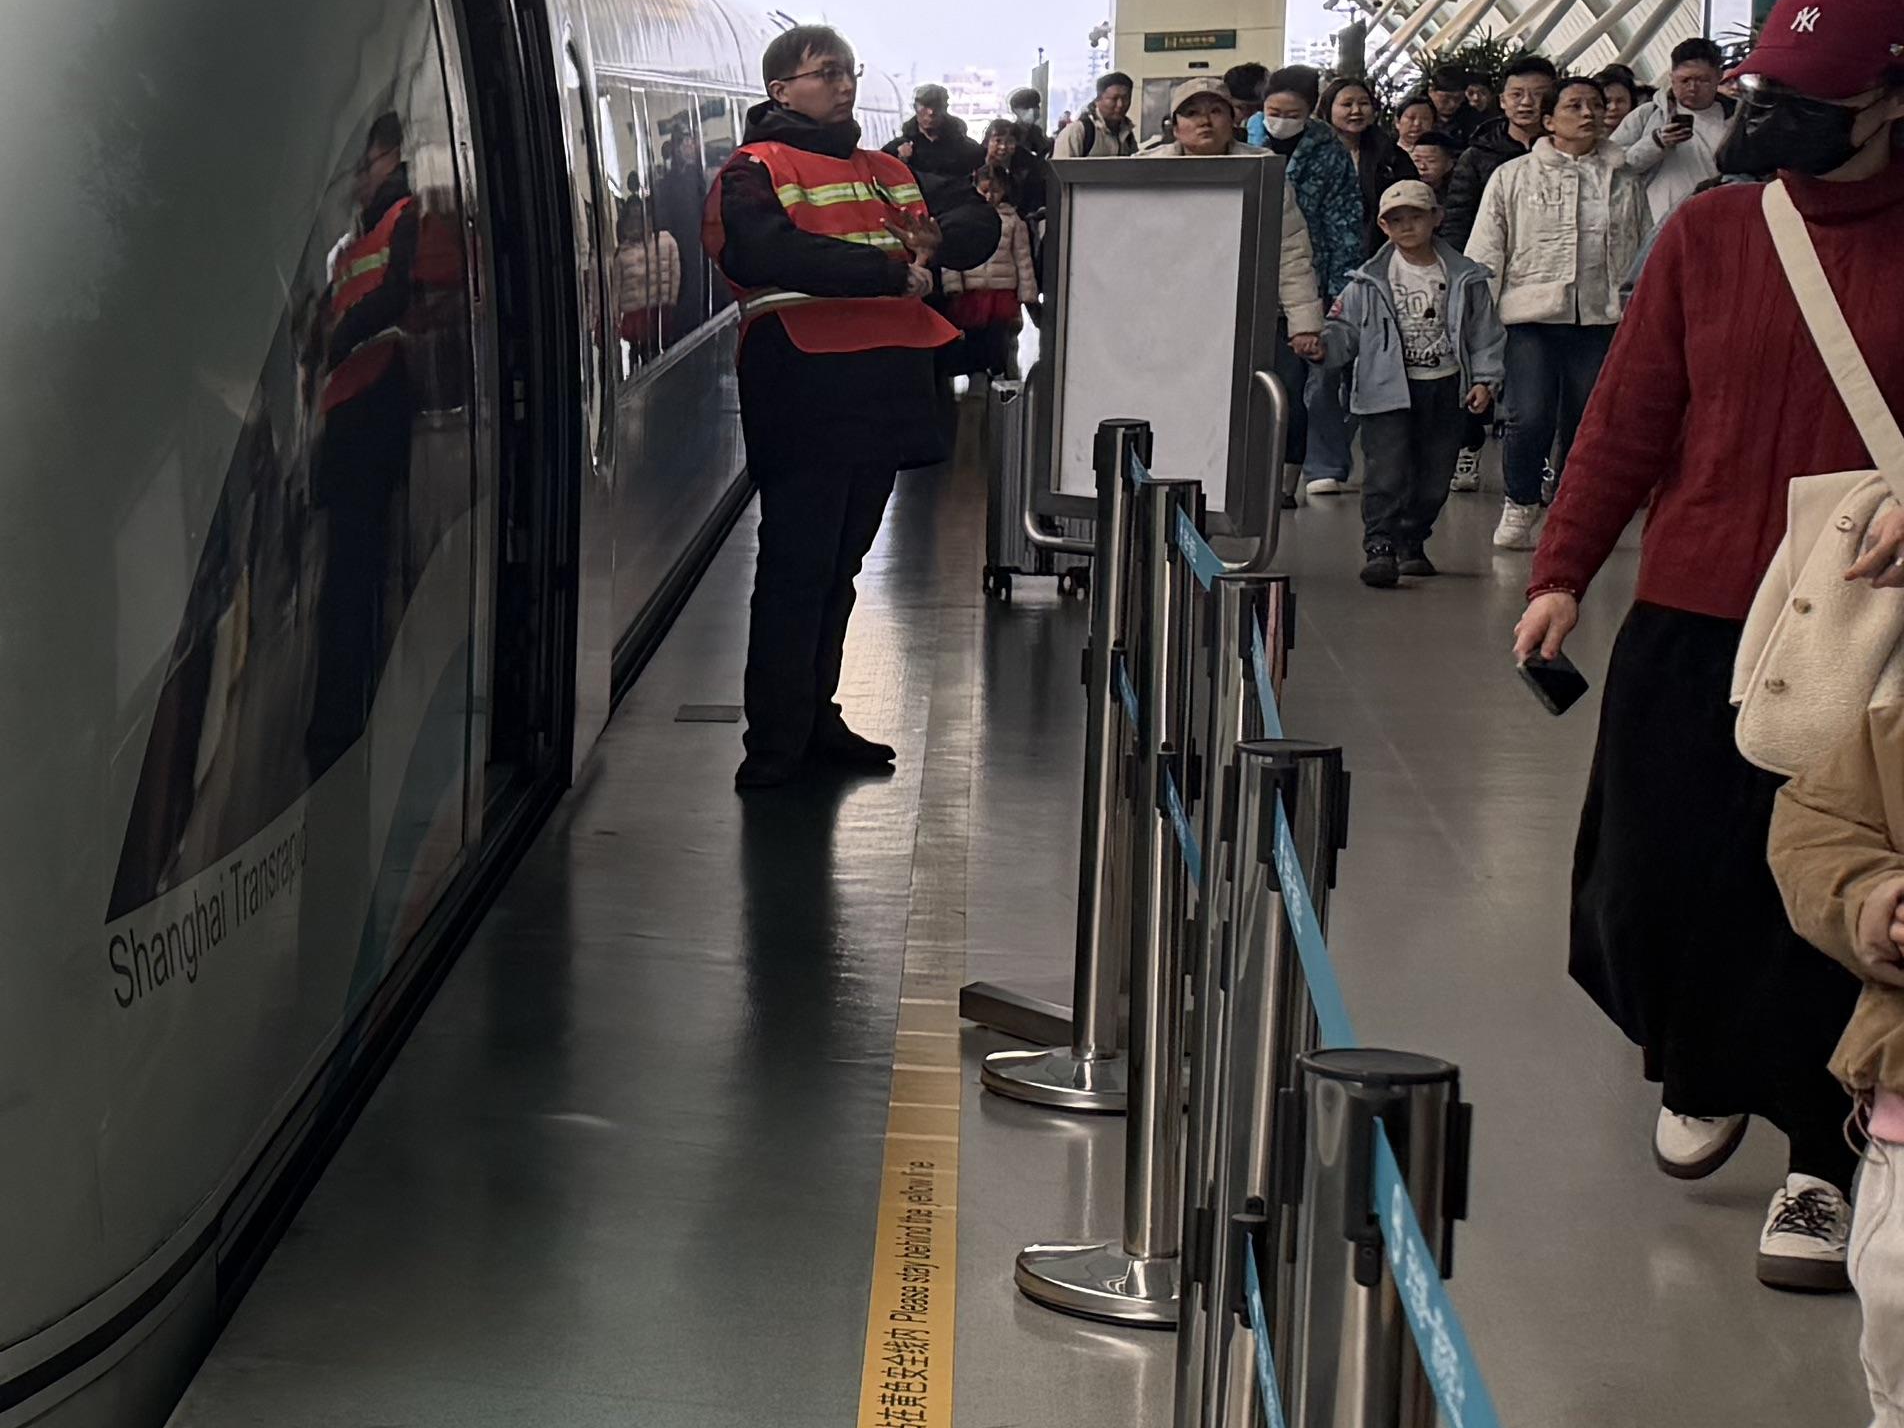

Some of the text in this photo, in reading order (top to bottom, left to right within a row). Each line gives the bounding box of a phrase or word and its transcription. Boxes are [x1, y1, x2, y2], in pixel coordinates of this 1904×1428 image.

[109, 874, 228, 1008] Shanghai
[897, 1208, 934, 1224] the
[894, 1225, 932, 1259] behind
[894, 1260, 940, 1284] stay
[888, 1285, 930, 1324] Please
